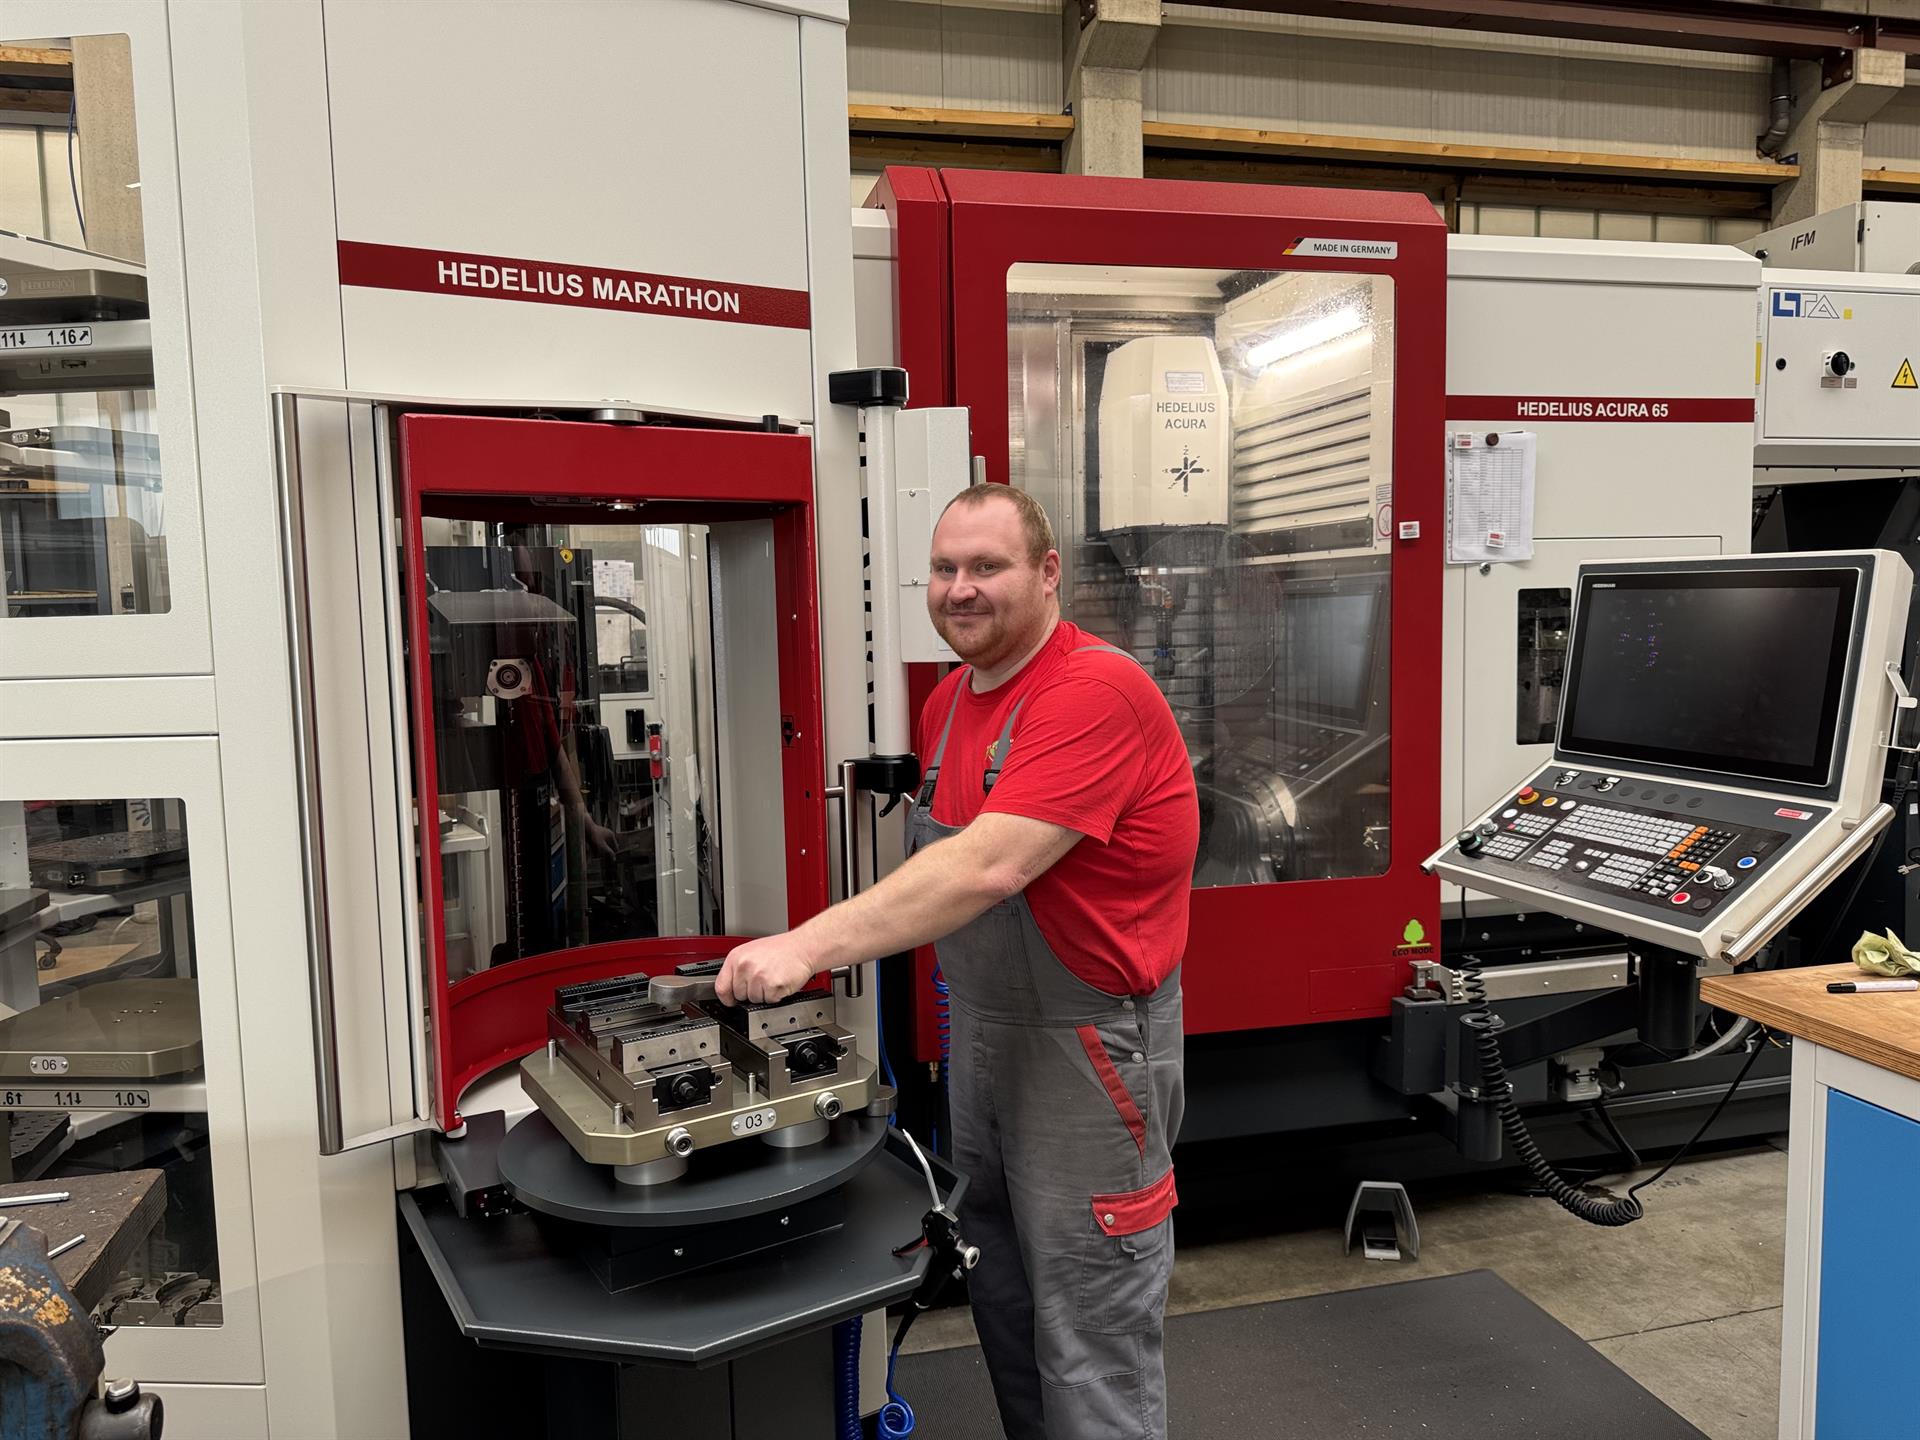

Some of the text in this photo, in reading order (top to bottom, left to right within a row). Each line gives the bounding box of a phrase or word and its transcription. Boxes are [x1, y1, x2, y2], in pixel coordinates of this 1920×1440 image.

[1791, 230, 1816, 251] IFM
[1313, 243, 1392, 255] MADE IN GERMANY
[438, 260, 740, 314] HEDELIUS MARATHON
[48, 329, 77, 346] 1.16
[1156, 402, 1215, 413] HEDELIUS
[1517, 402, 1669, 418] HEDELIUS ACURA 65
[1165, 419, 1207, 429] ACURA
[42, 1059, 57, 1071] 06
[54, 1092, 73, 1106] 1.1
[115, 1093, 135, 1106] 1.0
[745, 1113, 763, 1129] 03
